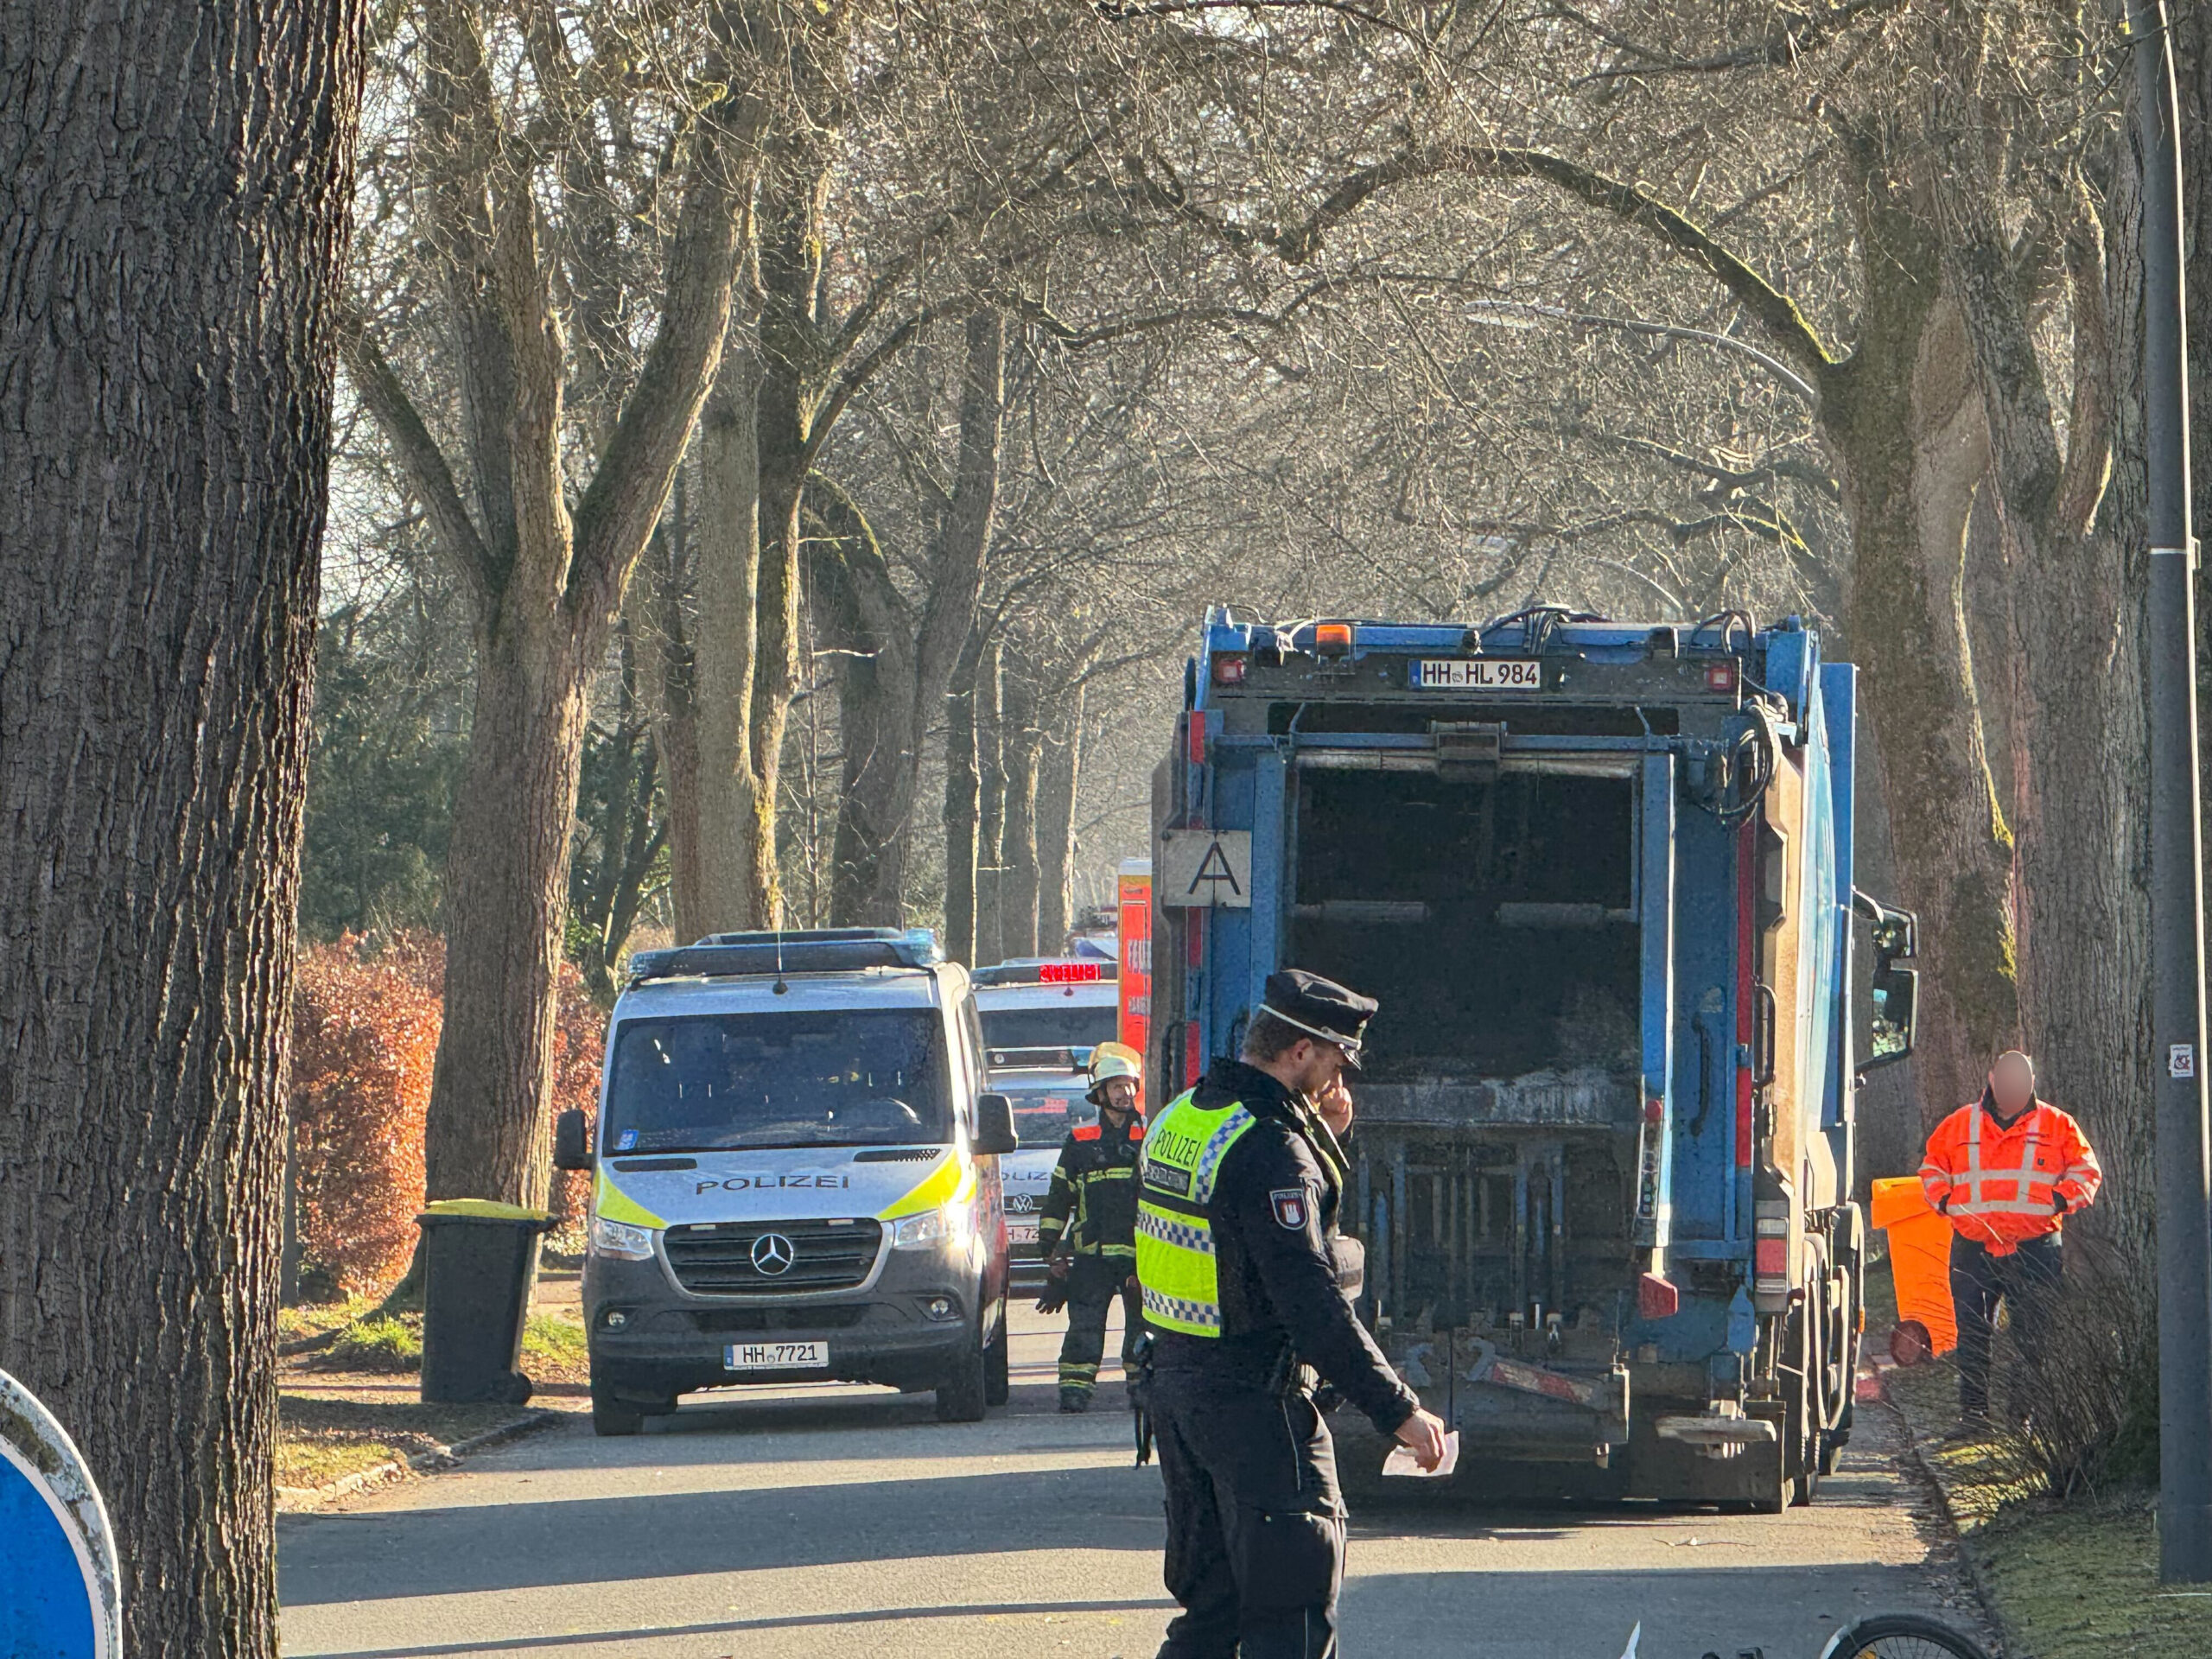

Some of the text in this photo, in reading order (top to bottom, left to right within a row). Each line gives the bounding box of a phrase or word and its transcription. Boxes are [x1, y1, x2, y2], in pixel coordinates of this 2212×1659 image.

[1423, 663, 1537, 685] HH HL 984
[1186, 841, 1242, 896] A
[1153, 1128, 1202, 1167] POLIZEI
[696, 1175, 849, 1195] POLIZEI
[743, 1344, 817, 1363] HH 7721
